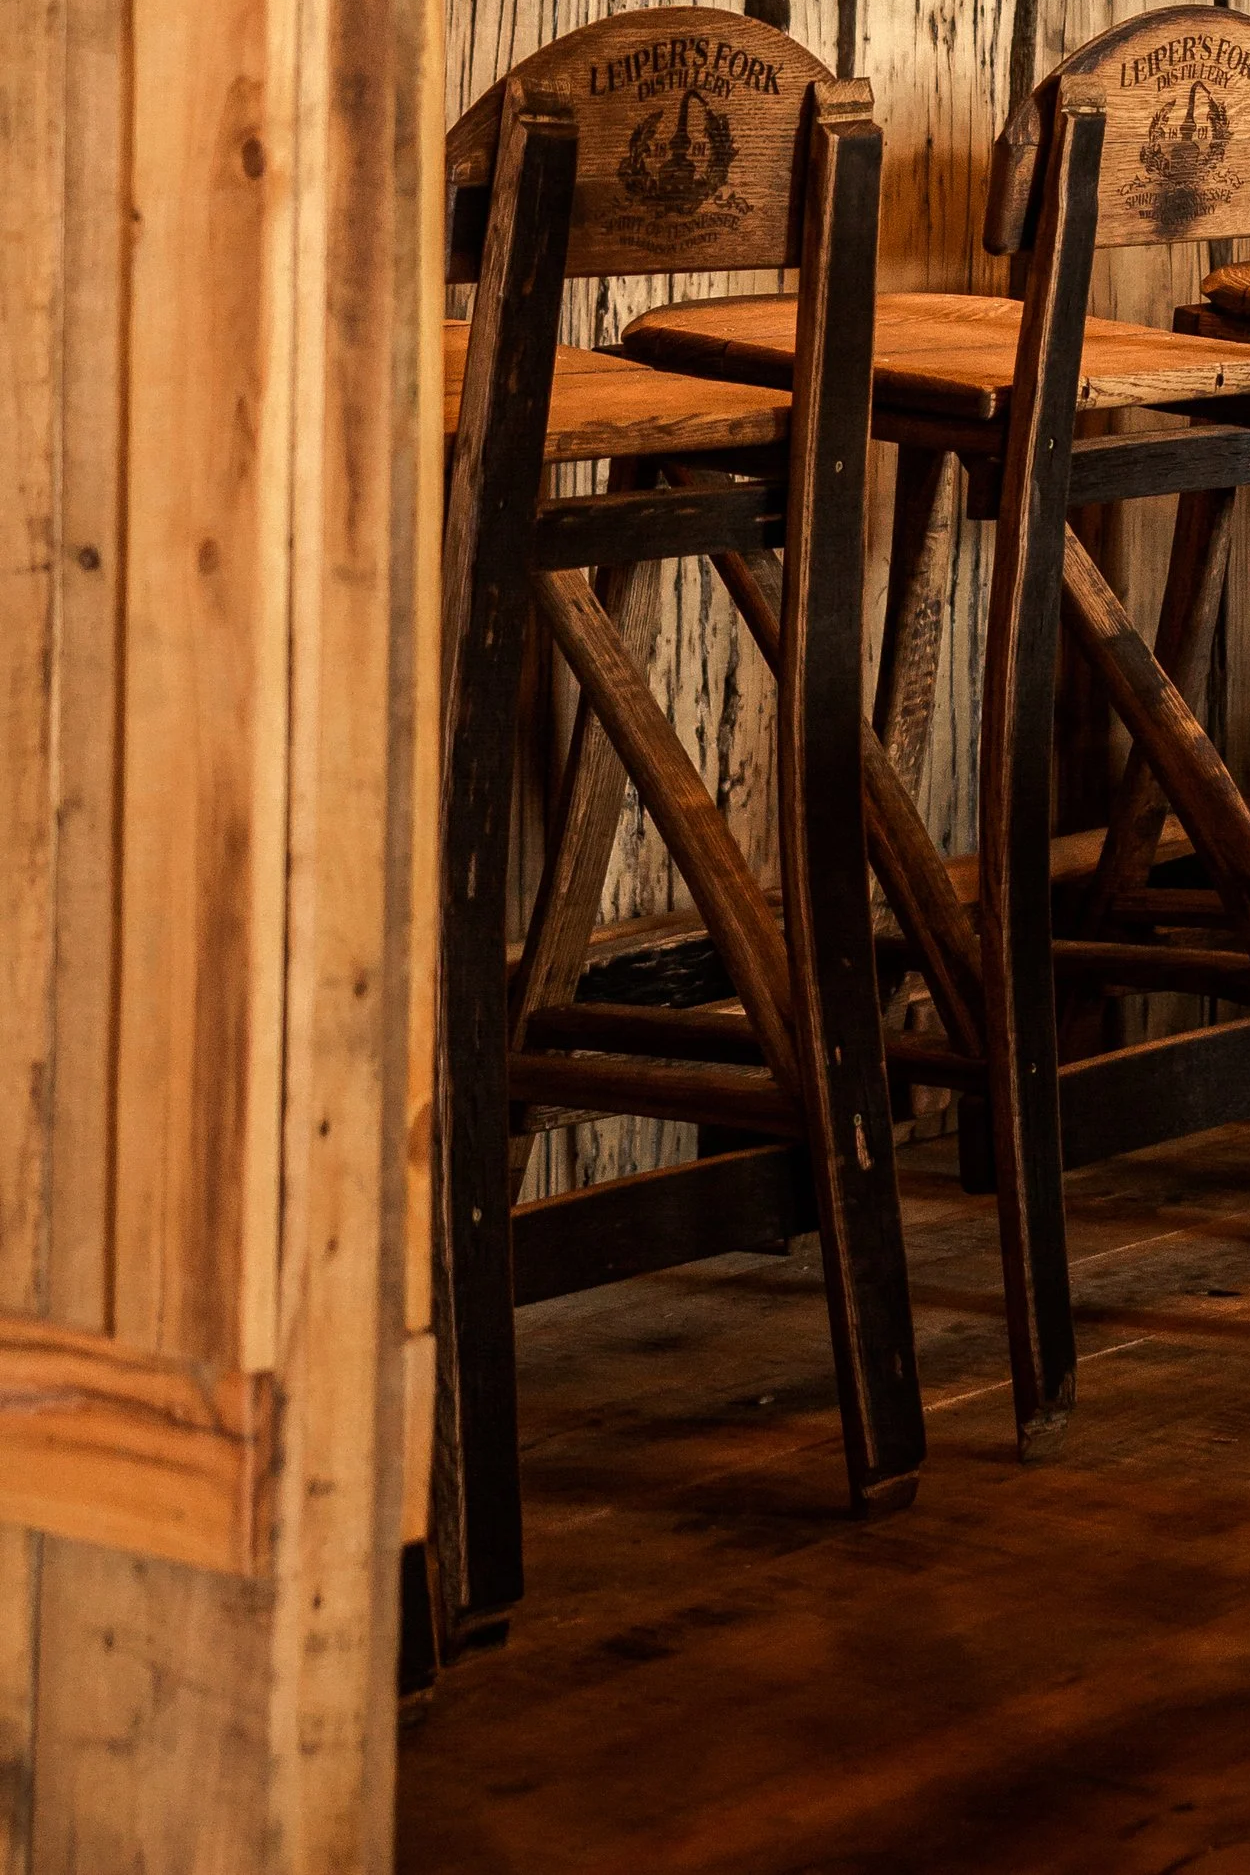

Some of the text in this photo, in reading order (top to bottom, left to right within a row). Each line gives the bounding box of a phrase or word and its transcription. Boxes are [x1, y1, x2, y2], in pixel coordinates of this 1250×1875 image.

[590, 37, 784, 96] LEIPER'S FORK
[1120, 34, 1213, 88] LEIPER'S
[1157, 63, 1232, 92] DISTILLERY
[638, 68, 735, 102] DISTILLERY
